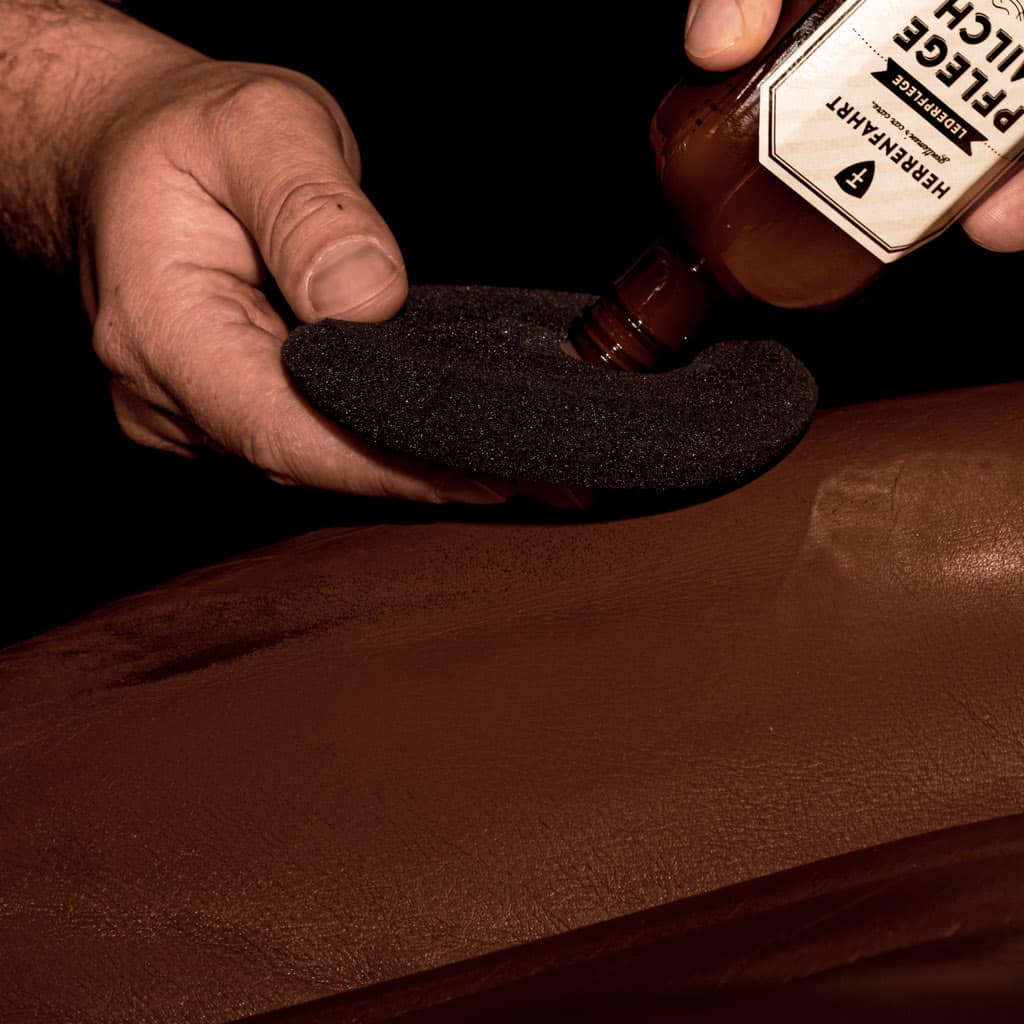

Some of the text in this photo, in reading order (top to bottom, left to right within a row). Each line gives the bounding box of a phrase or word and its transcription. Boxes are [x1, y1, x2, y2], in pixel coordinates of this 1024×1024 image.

[891, 74, 967, 138] LEDERPFLEGE
[892, 15, 1024, 133] PFLEGE
[825, 95, 950, 199] HERRENFAHRT
[890, 117, 904, 130] car
